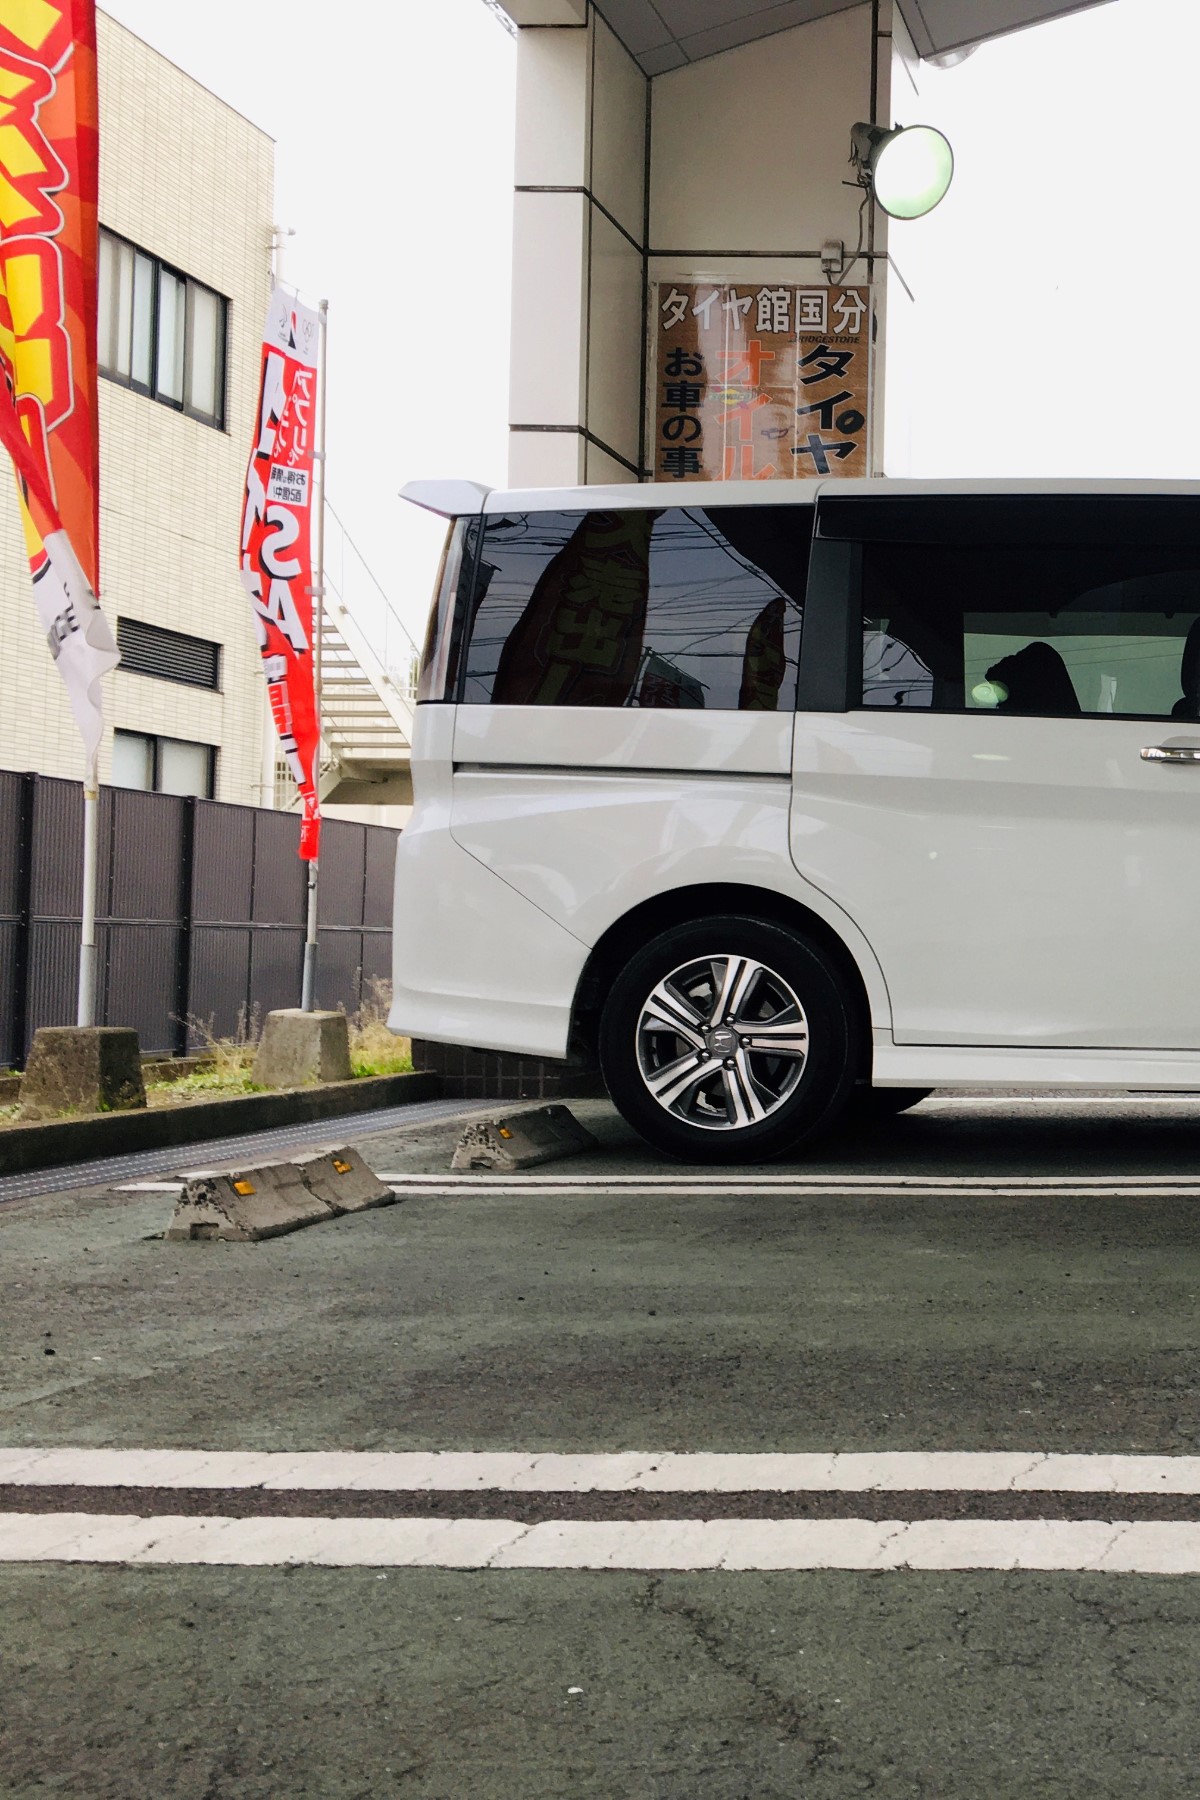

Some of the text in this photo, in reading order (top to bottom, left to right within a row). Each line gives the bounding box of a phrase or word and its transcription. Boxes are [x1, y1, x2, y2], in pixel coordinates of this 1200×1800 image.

[661, 287, 867, 334] タイヤ館国分
[661, 347, 704, 478] お車の事
[791, 344, 860, 475] タイヤ
